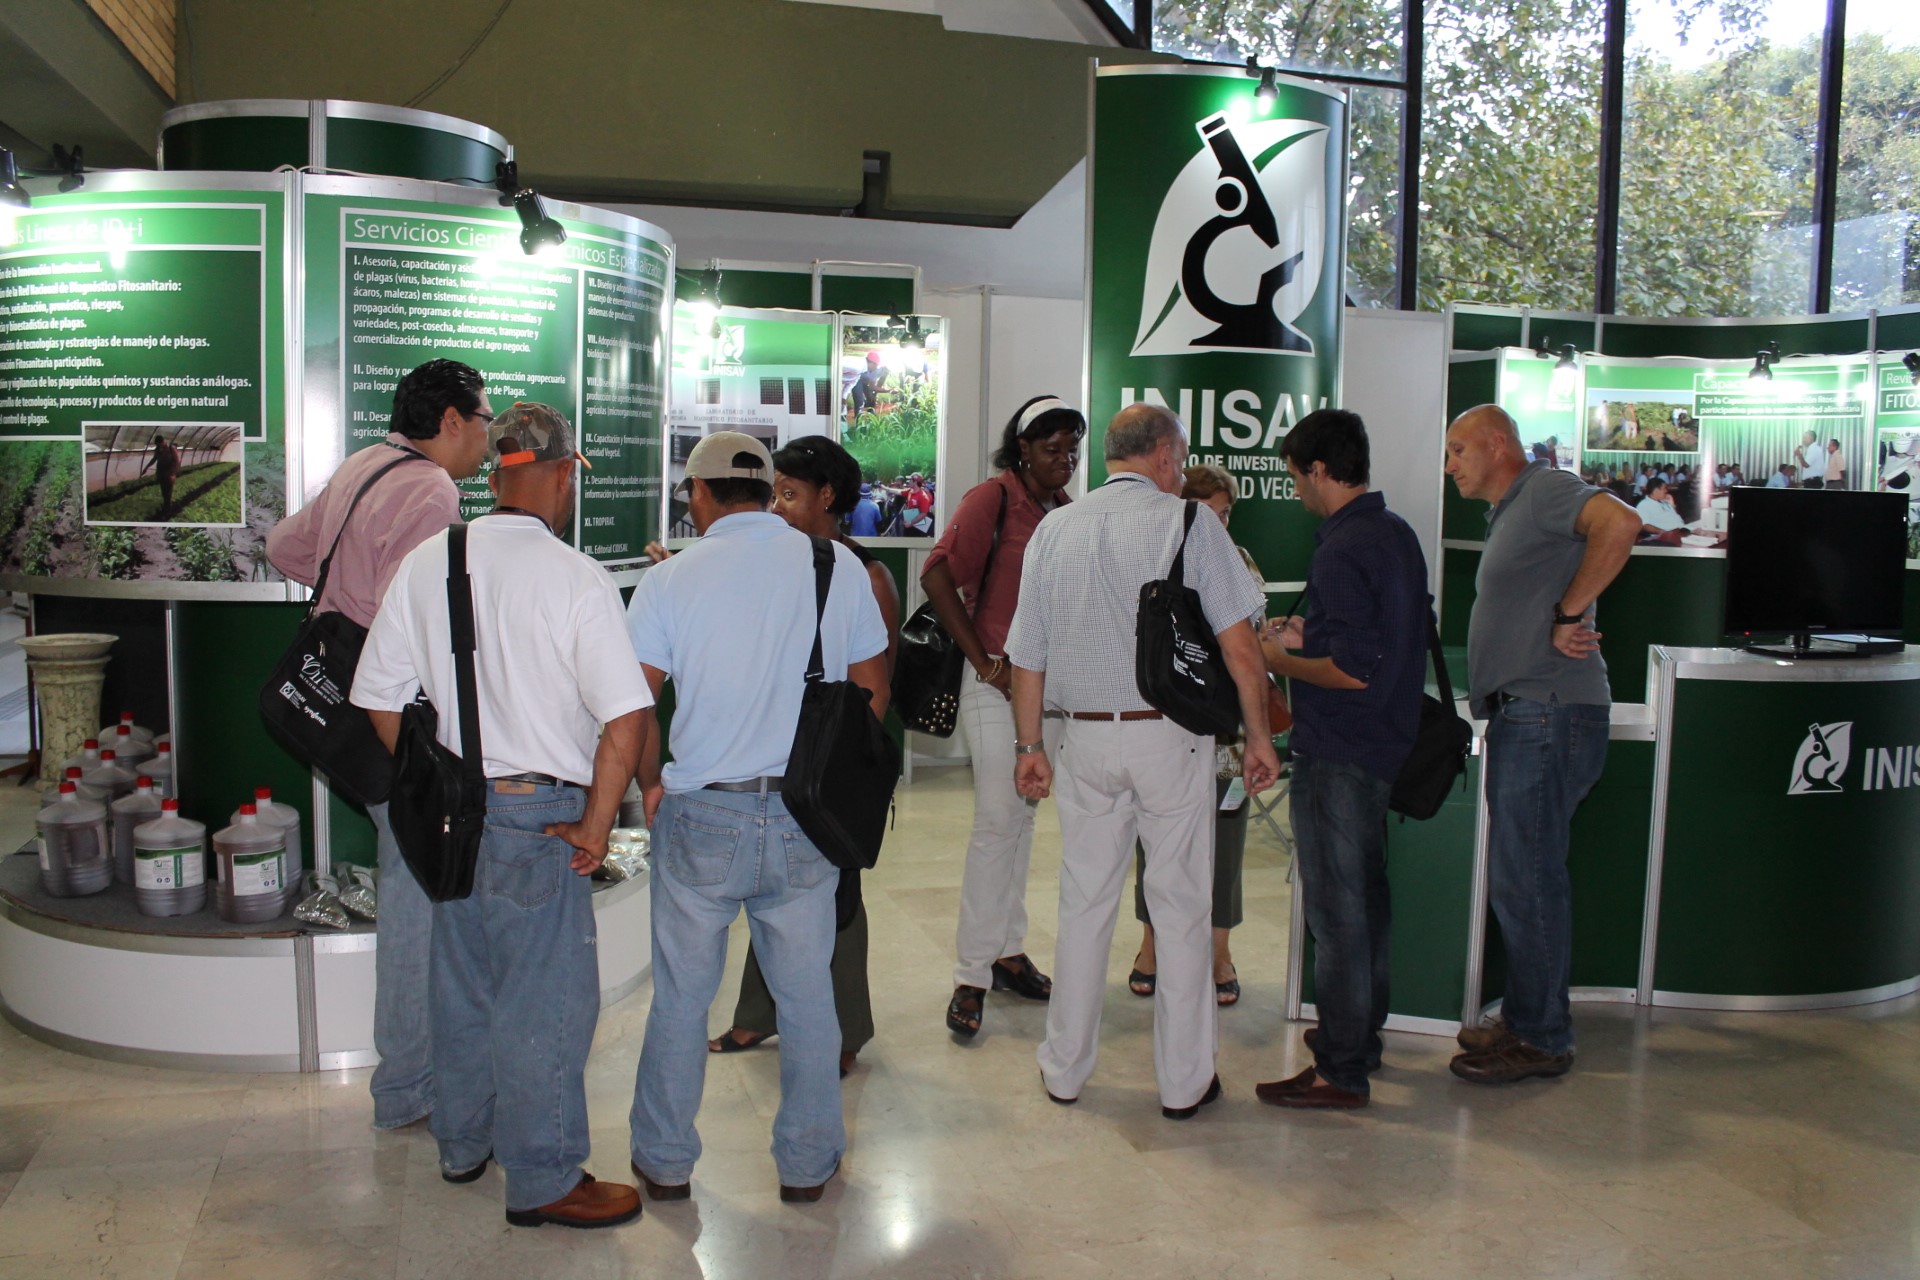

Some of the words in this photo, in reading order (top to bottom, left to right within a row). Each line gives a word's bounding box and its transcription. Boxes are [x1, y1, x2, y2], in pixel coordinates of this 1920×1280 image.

[354, 218, 450, 244] Servicios
[354, 255, 361, 266] I.
[362, 256, 400, 269] Asesoría,
[402, 258, 450, 272] capacitación
[452, 264, 456, 274] y
[354, 271, 364, 282] de
[366, 272, 394, 284] plagas
[396, 274, 420, 286] (virus,
[422, 274, 459, 288] bacterias,
[588, 278, 596, 288] VI.
[59, 282, 68, 294] de
[69, 280, 117, 295] Diagnóstico
[118, 280, 182, 292] Fitosanitario:
[354, 286, 382, 299] ácaros,
[384, 288, 420, 301] malezas)
[434, 292, 467, 304] sistemas
[468, 294, 478, 304] de
[588, 293, 606, 304] manejo
[91, 298, 124, 312] riesgos,
[354, 304, 406, 316] propagación,
[408, 306, 451, 318] programas
[452, 308, 462, 317] de
[463, 308, 500, 320] desarrollo
[588, 306, 608, 316] sistemas
[608, 308, 614, 318] de
[50, 318, 58, 329] de
[60, 317, 87, 331] plagas.
[354, 319, 400, 330] variedades,
[402, 321, 456, 334] post-cosecha,
[457, 324, 498, 336] almacenes,
[499, 327, 534, 339] transporte
[534, 331, 538, 340] y
[24, 338, 59, 351] tecnologías
[66, 336, 109, 350] estrategias
[110, 336, 122, 346] de
[123, 335, 158, 349] manejo
[160, 335, 172, 346] de
[174, 335, 210, 349] plagas.
[354, 334, 420, 346] comercialización
[422, 336, 432, 346] de
[434, 337, 472, 349] productos
[472, 340, 484, 349] del
[486, 342, 502, 352] agro
[502, 342, 530, 354] negocio.
[587, 334, 598, 344] VII.
[16, 357, 52, 369] Fitosanitaria
[54, 356, 104, 370] participativa.
[354, 364, 364, 374] II.
[366, 364, 394, 376] Diseño
[395, 368, 400, 378] y
[488, 371, 526, 382] producción
[526, 374, 566, 384] agropecuaria
[12, 377, 38, 391] vigilancia
[39, 376, 47, 388] de
[48, 376, 58, 387] los
[58, 376, 101, 389] plaguicidas
[102, 375, 141, 388] químicos
[143, 377, 148, 388] y
[150, 375, 200, 387] sustancias
[202, 376, 252, 390] análogas.
[353, 381, 372, 392] para
[374, 382, 398, 392] lograr
[493, 385, 502, 395] de
[504, 386, 527, 398] Plagas.
[22, 396, 59, 409] tecnologías,
[60, 398, 92, 409] procesos
[92, 398, 98, 408] y
[98, 394, 142, 408] productos
[144, 394, 155, 406] de
[158, 395, 189, 409] origen
[191, 396, 228, 406] natural
[1700, 396, 1712, 404] Por
[1714, 396, 1720, 404] la
[28, 412, 49, 426] plagas.
[354, 411, 367, 421] III.
[353, 427, 389, 439] agrícolas
[586, 433, 594, 442] IX.
[586, 446, 604, 457] Sanidad
[585, 476, 590, 484] X.
[584, 490, 612, 499] información
[1260, 477, 1301, 500] VEG
[584, 518, 592, 526] XI.
[304, 705, 327, 727] syngenta
